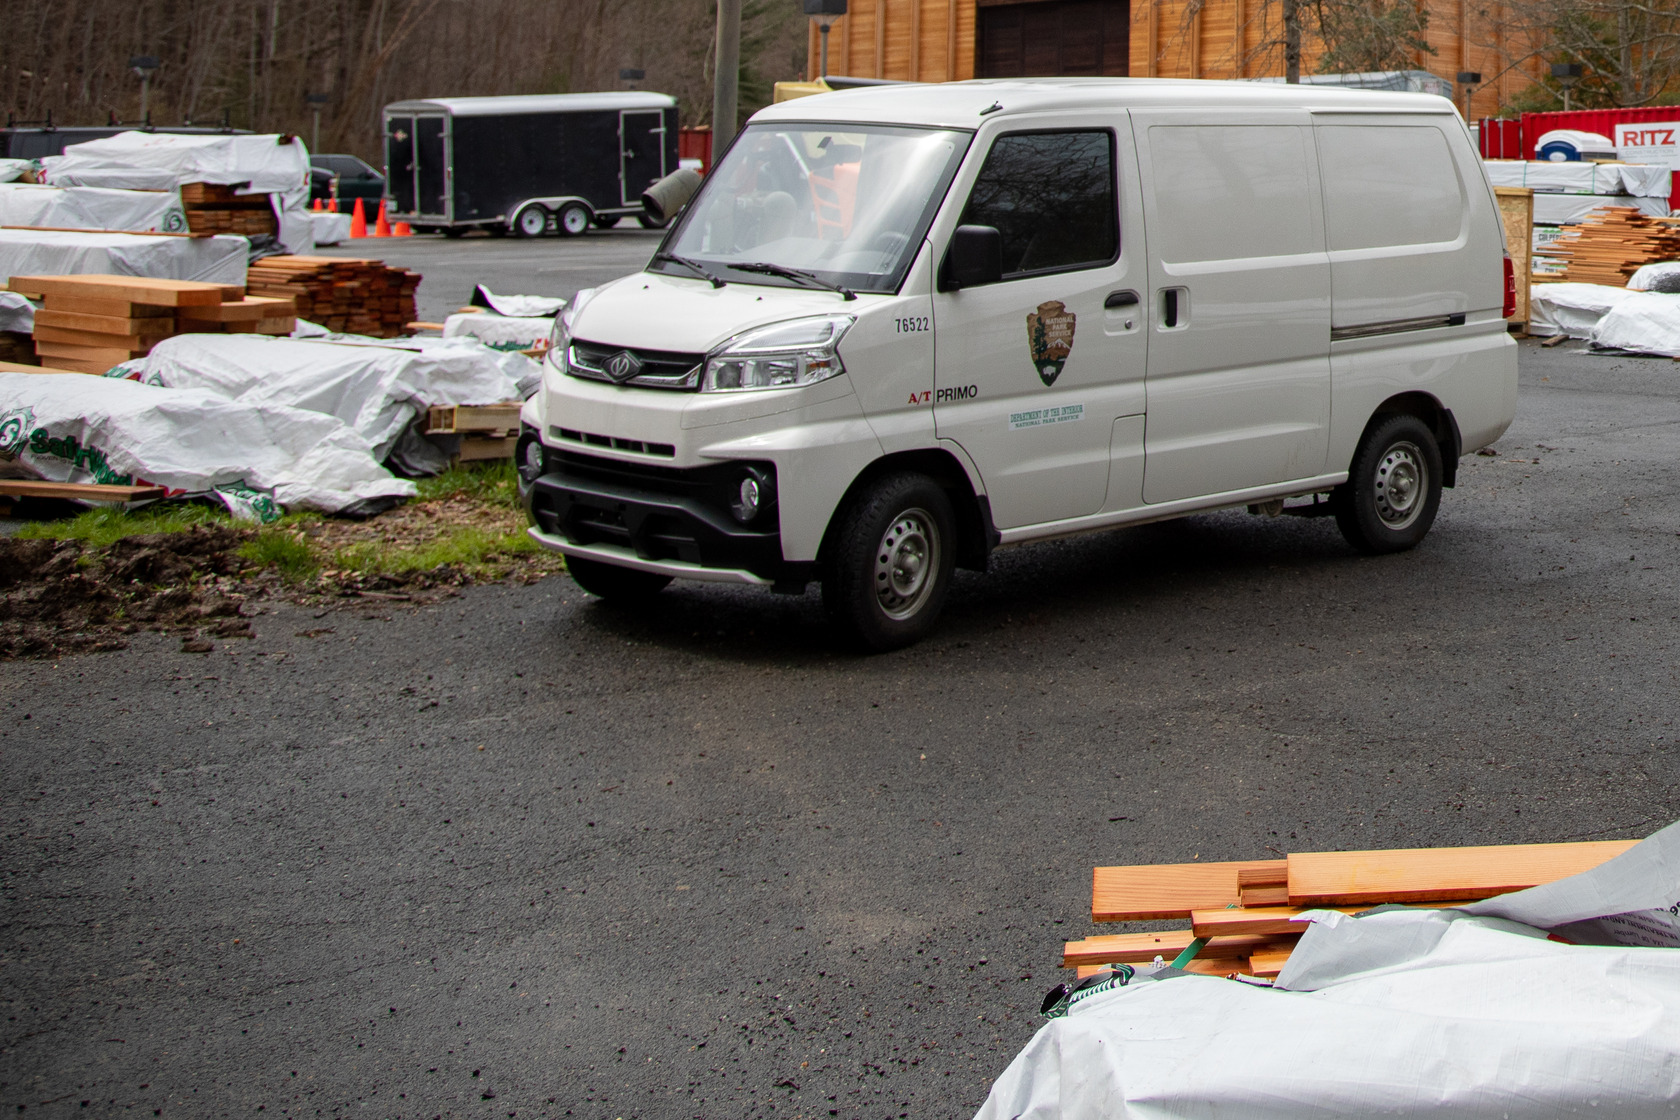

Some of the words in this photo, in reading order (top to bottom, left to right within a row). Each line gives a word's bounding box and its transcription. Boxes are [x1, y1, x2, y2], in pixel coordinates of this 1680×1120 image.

[1623, 129, 1676, 147] RITZ
[895, 316, 929, 333] 76522
[1046, 316, 1073, 325] NATIONAL
[908, 391, 932, 405] A/T
[936, 384, 978, 403] PRIMO
[1010, 410, 1042, 423] DEPARTMENT
[1043, 409, 1049, 418] OF
[1050, 407, 1060, 417] THE
[1061, 404, 1083, 416] INTERIOR
[1015, 420, 1041, 428] NATIONAL
[1057, 414, 1079, 422] SERVICE
